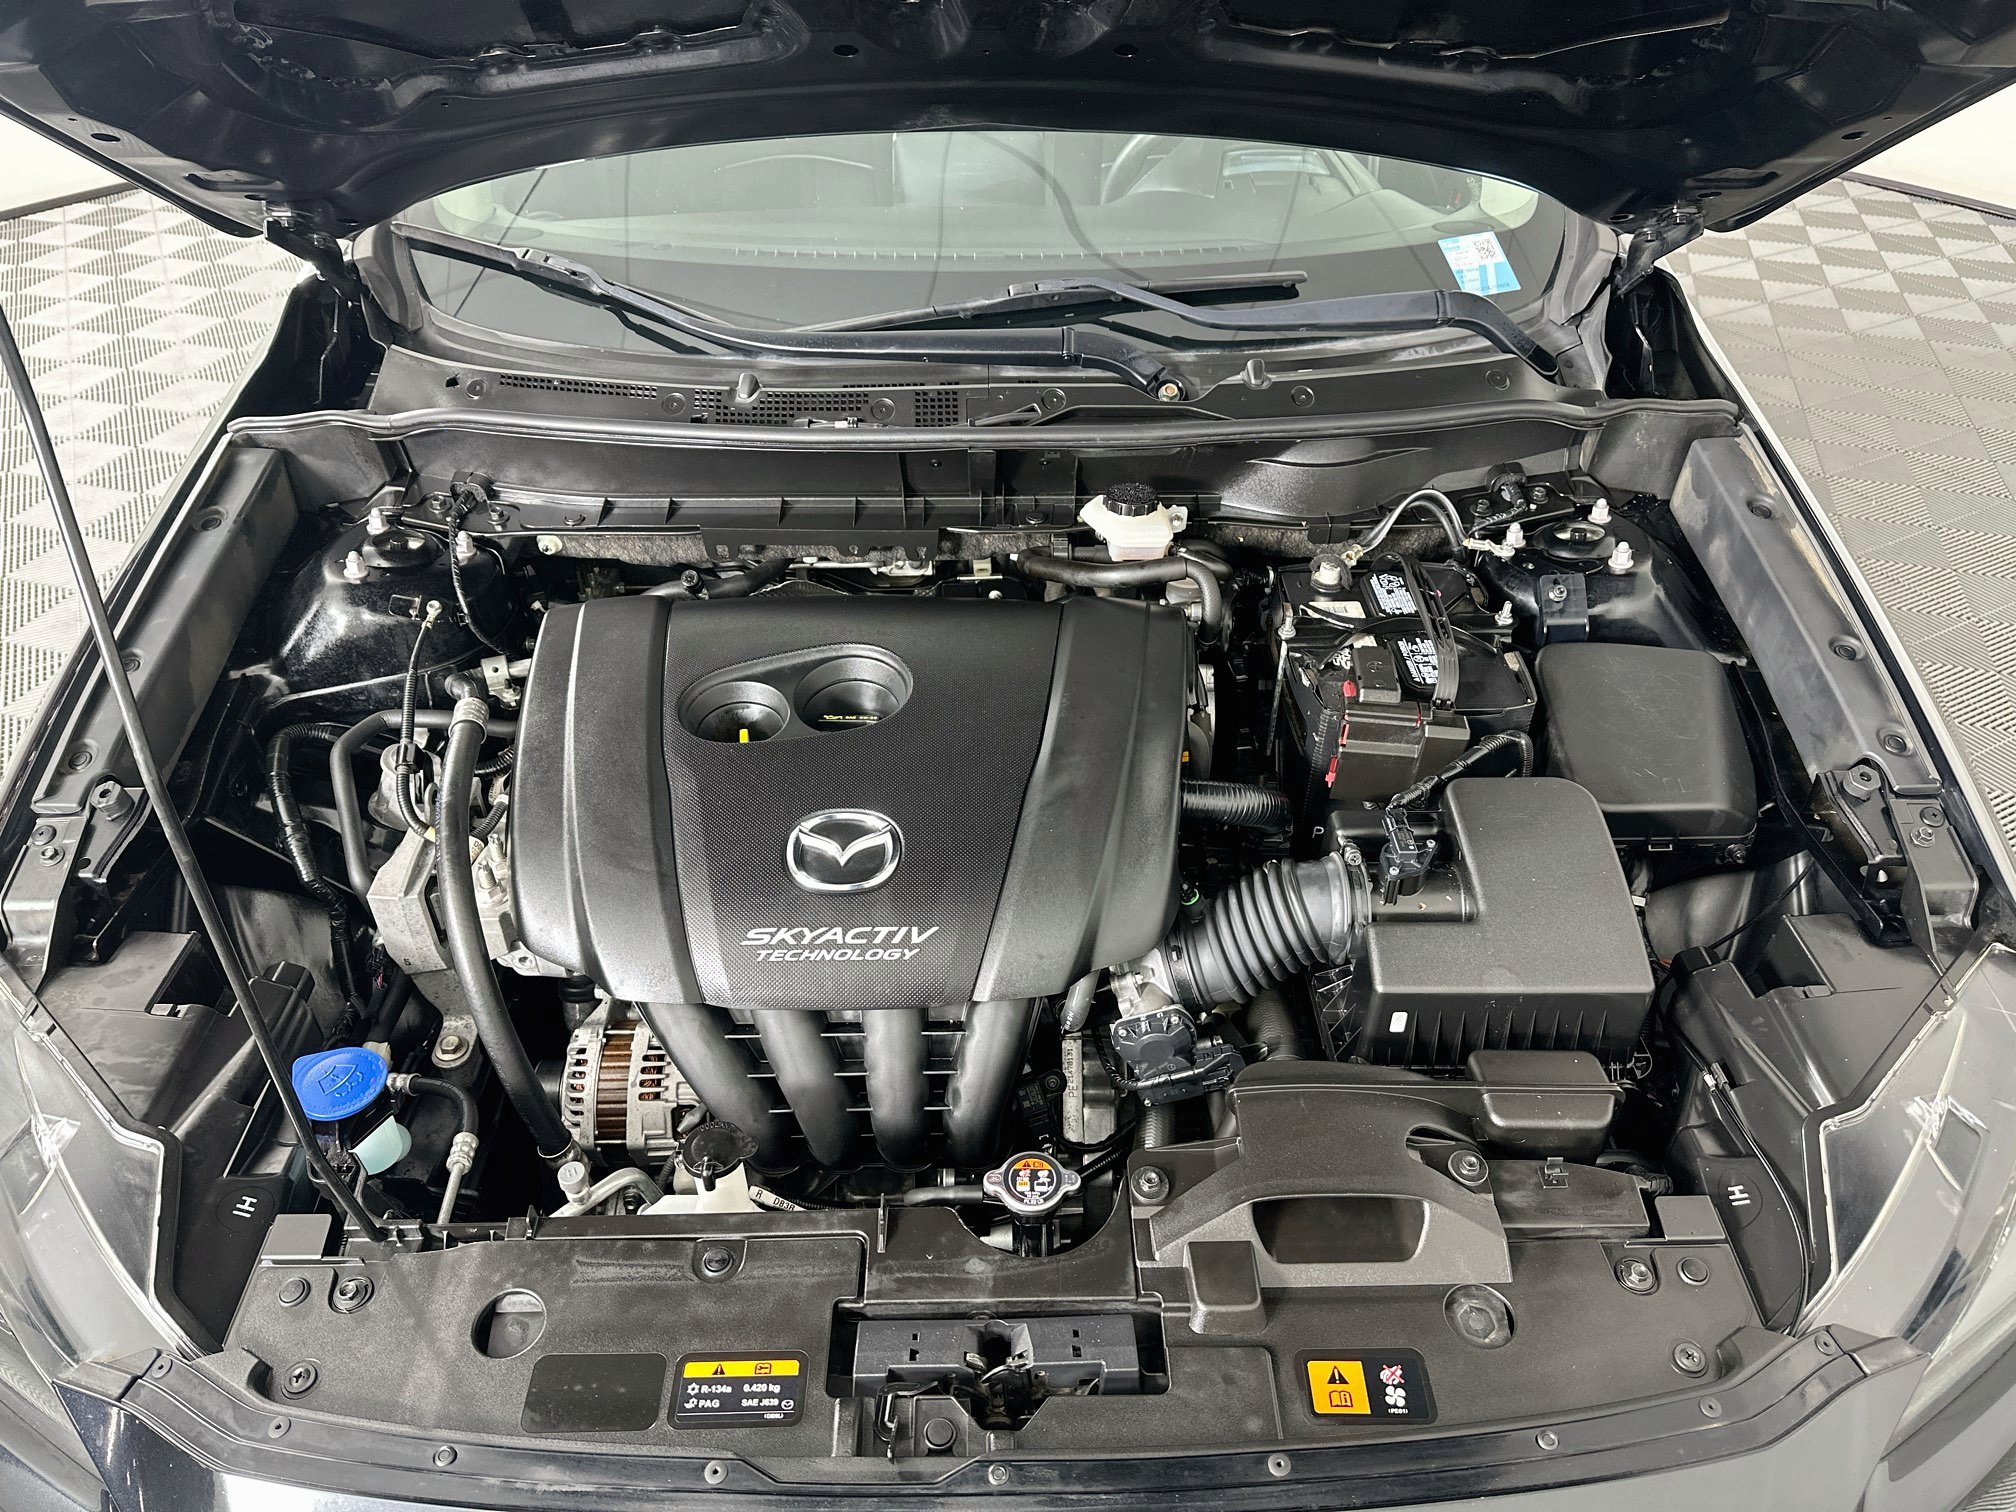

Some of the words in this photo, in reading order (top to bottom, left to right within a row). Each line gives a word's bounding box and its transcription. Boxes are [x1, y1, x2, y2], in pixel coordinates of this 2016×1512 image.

[740, 926, 940, 946] SKYACTIV
[756, 948, 921, 962] TECHNOLOGY
[755, 1188, 764, 1199] R
[701, 1384, 732, 1393] R-134a
[768, 1383, 781, 1393] kg
[698, 1399, 720, 1408] PAG
[741, 1398, 759, 1407] SAE
